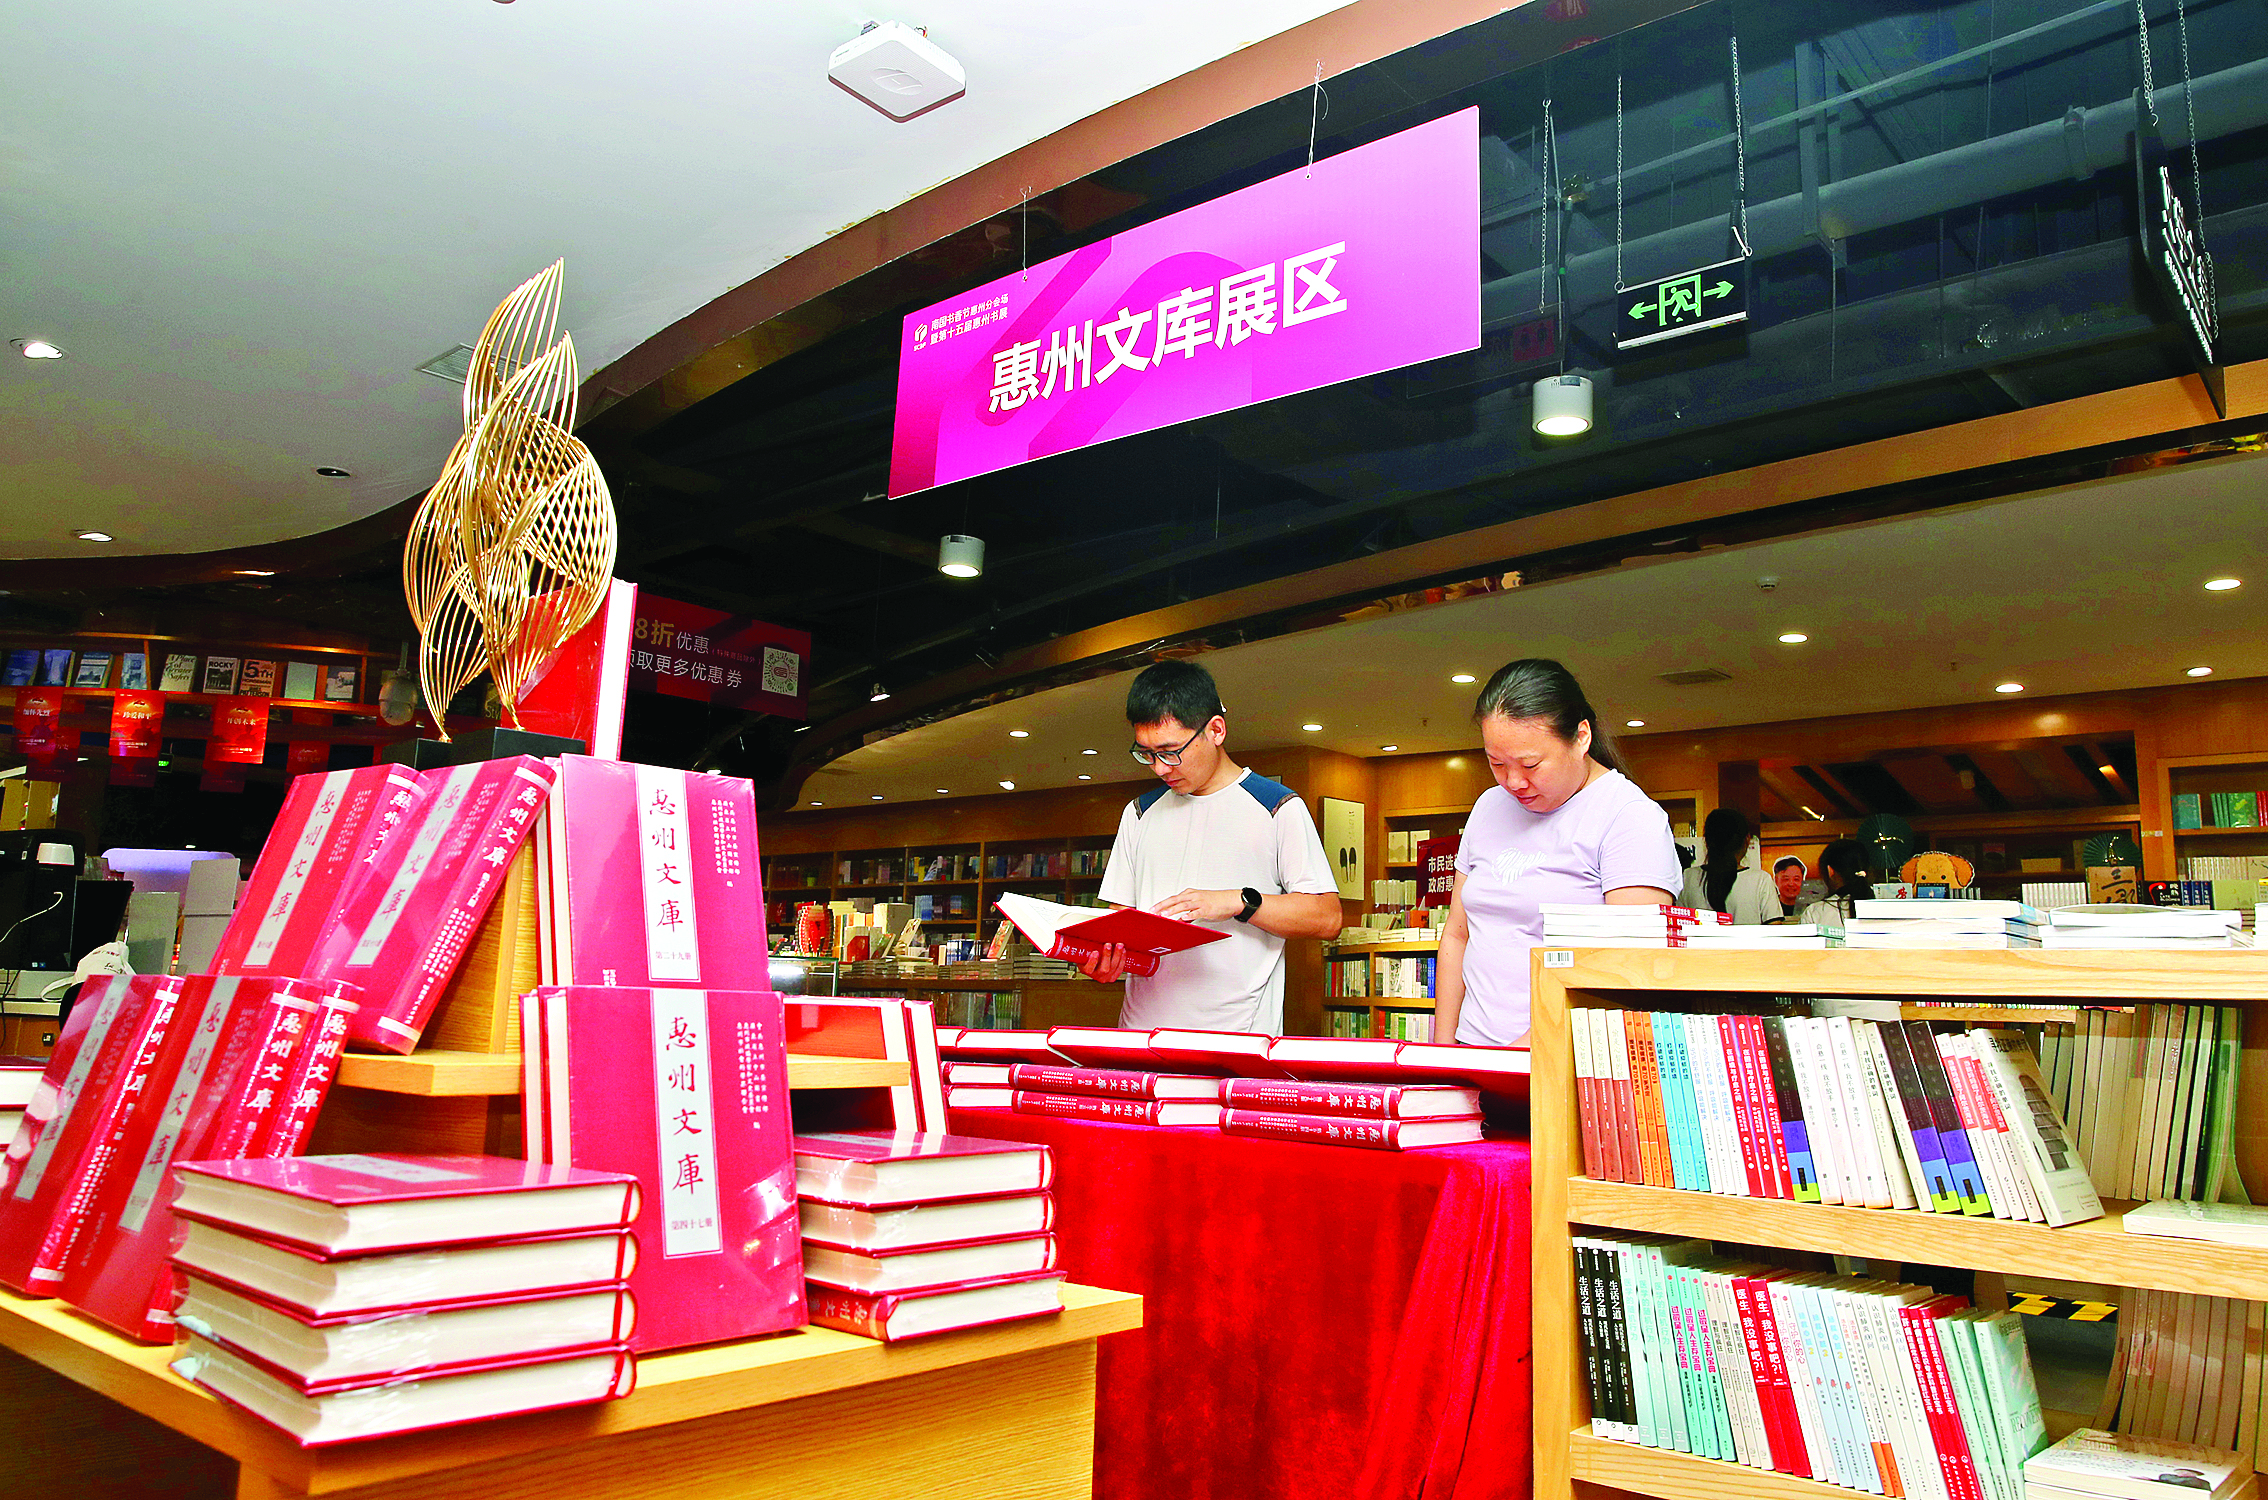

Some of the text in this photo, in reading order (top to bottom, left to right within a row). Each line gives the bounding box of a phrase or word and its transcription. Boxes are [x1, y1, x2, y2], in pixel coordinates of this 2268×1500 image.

[929, 306, 1008, 346] 暨第十五届惠州书展
[930, 293, 1009, 332] 南国书香节惠州分会场
[988, 240, 1349, 413] 惠州文库展区
[122, 711, 152, 720] 珍爱和平
[649, 789, 684, 933] 惠州文庫
[1428, 853, 1458, 873] 市民选
[665, 1016, 704, 1195] 惠州文庫
[1800, 1072, 1810, 1100] 我不放手
[1822, 1074, 1834, 1102] 我不放手
[1845, 1073, 1857, 1101] 我不放手
[1578, 1276, 1592, 1316] 生活之道
[1594, 1278, 1608, 1318] 生活之道
[1609, 1280, 1623, 1320] 生活之道
